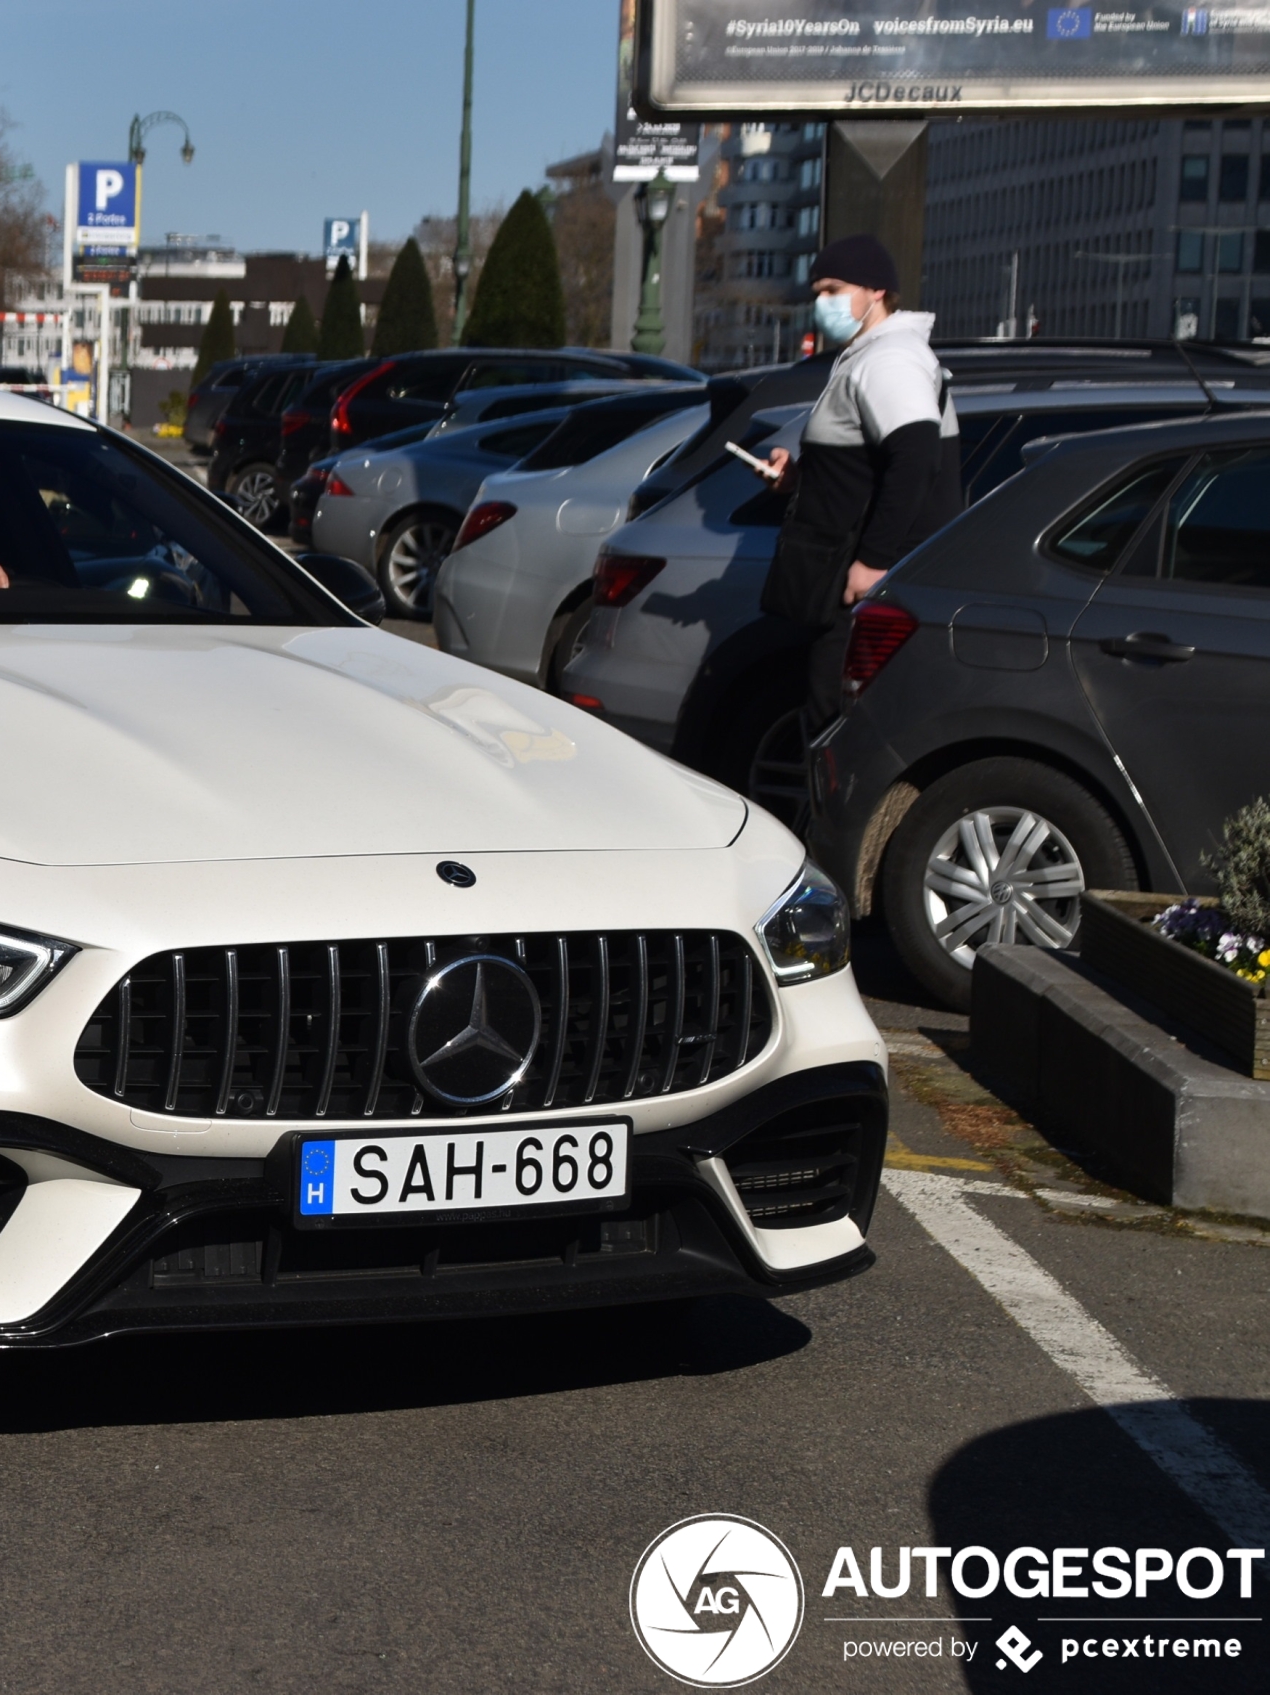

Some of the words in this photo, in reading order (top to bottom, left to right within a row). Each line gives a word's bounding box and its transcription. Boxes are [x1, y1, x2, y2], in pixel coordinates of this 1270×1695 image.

[726, 18, 860, 39] #Syria10YearsOn
[873, 15, 1034, 37] voicesfromSyria.eu
[1094, 12, 1124, 22] Funded
[1108, 21, 1145, 32] European
[1146, 20, 1169, 31] Union
[845, 81, 962, 102] JCDecaux
[96, 169, 123, 211] P
[331, 220, 349, 246] P
[350, 1131, 613, 1204] SAH-668
[307, 1183, 324, 1204] H
[435, 1208, 512, 1222] www.pappas.hu
